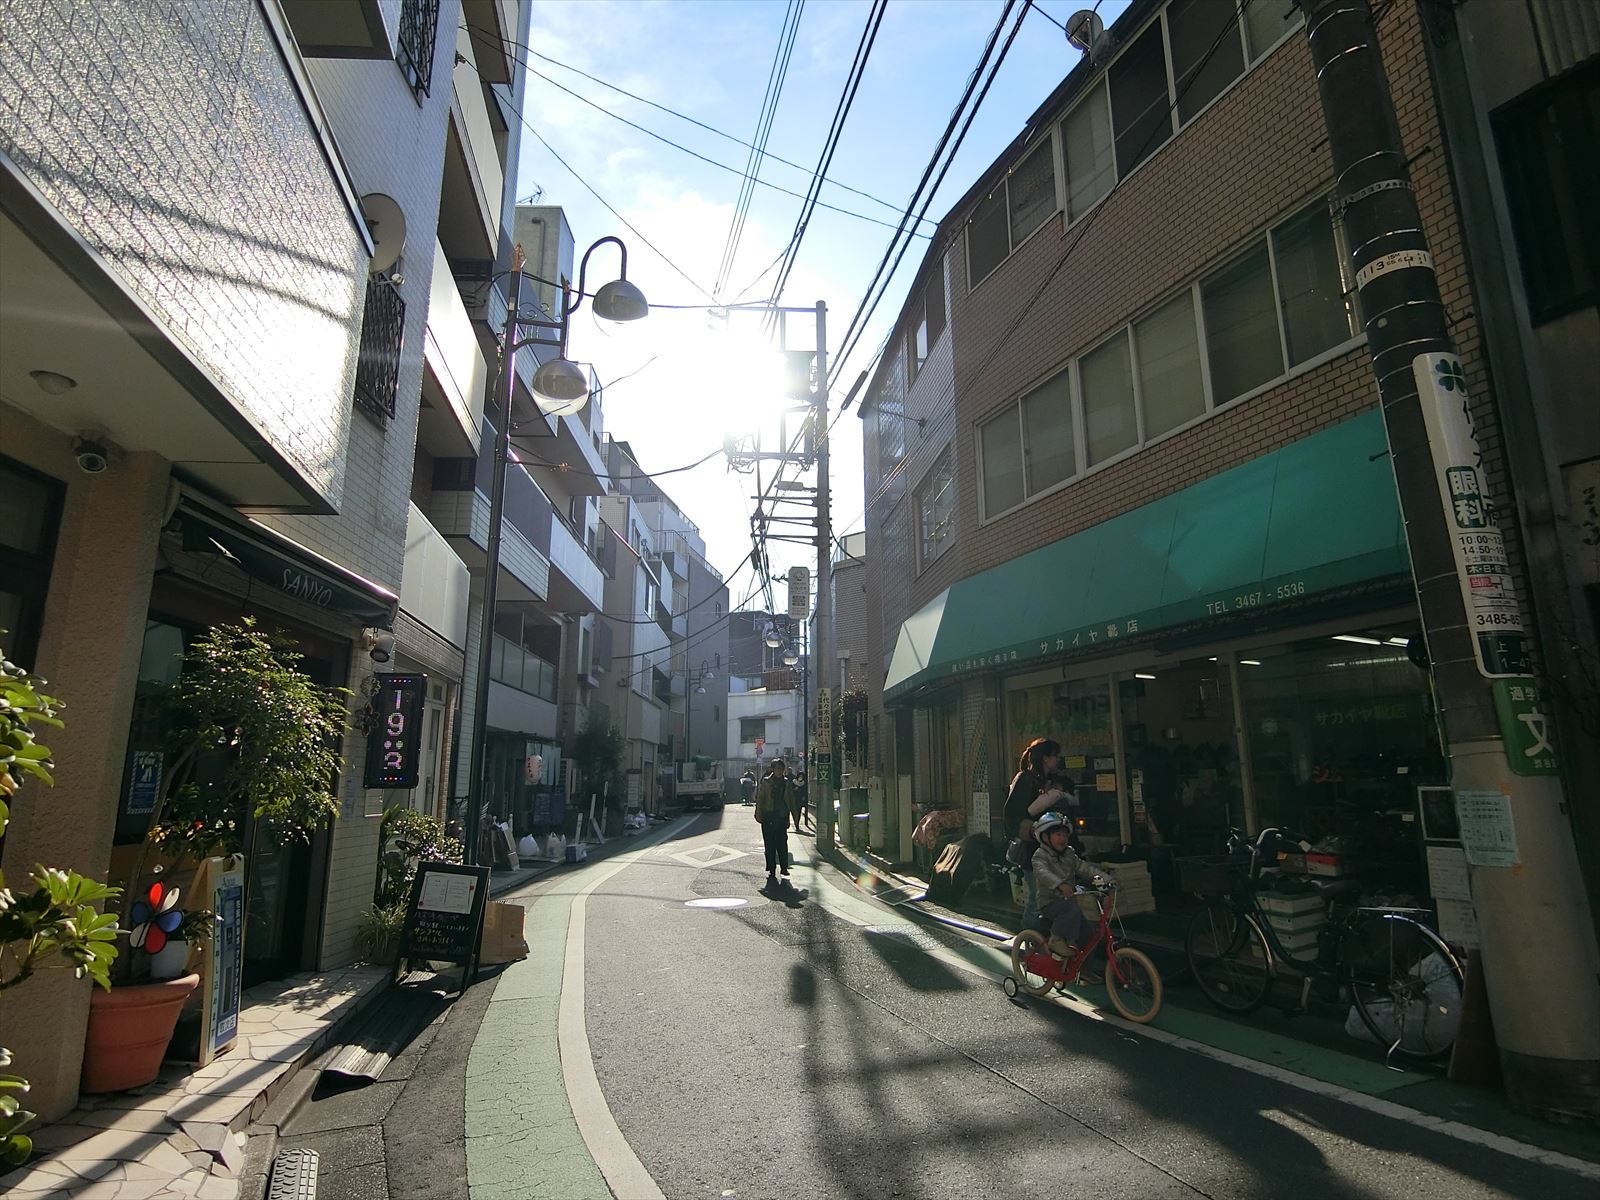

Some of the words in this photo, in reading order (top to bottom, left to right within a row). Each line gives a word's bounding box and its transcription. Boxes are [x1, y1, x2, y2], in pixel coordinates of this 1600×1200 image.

[1449, 471, 1485, 526] 眼科
[281, 568, 333, 607] SANYO
[1206, 601, 1229, 616] TEL
[1235, 591, 1262, 611] 3467
[1277, 582, 1306, 601] 5536
